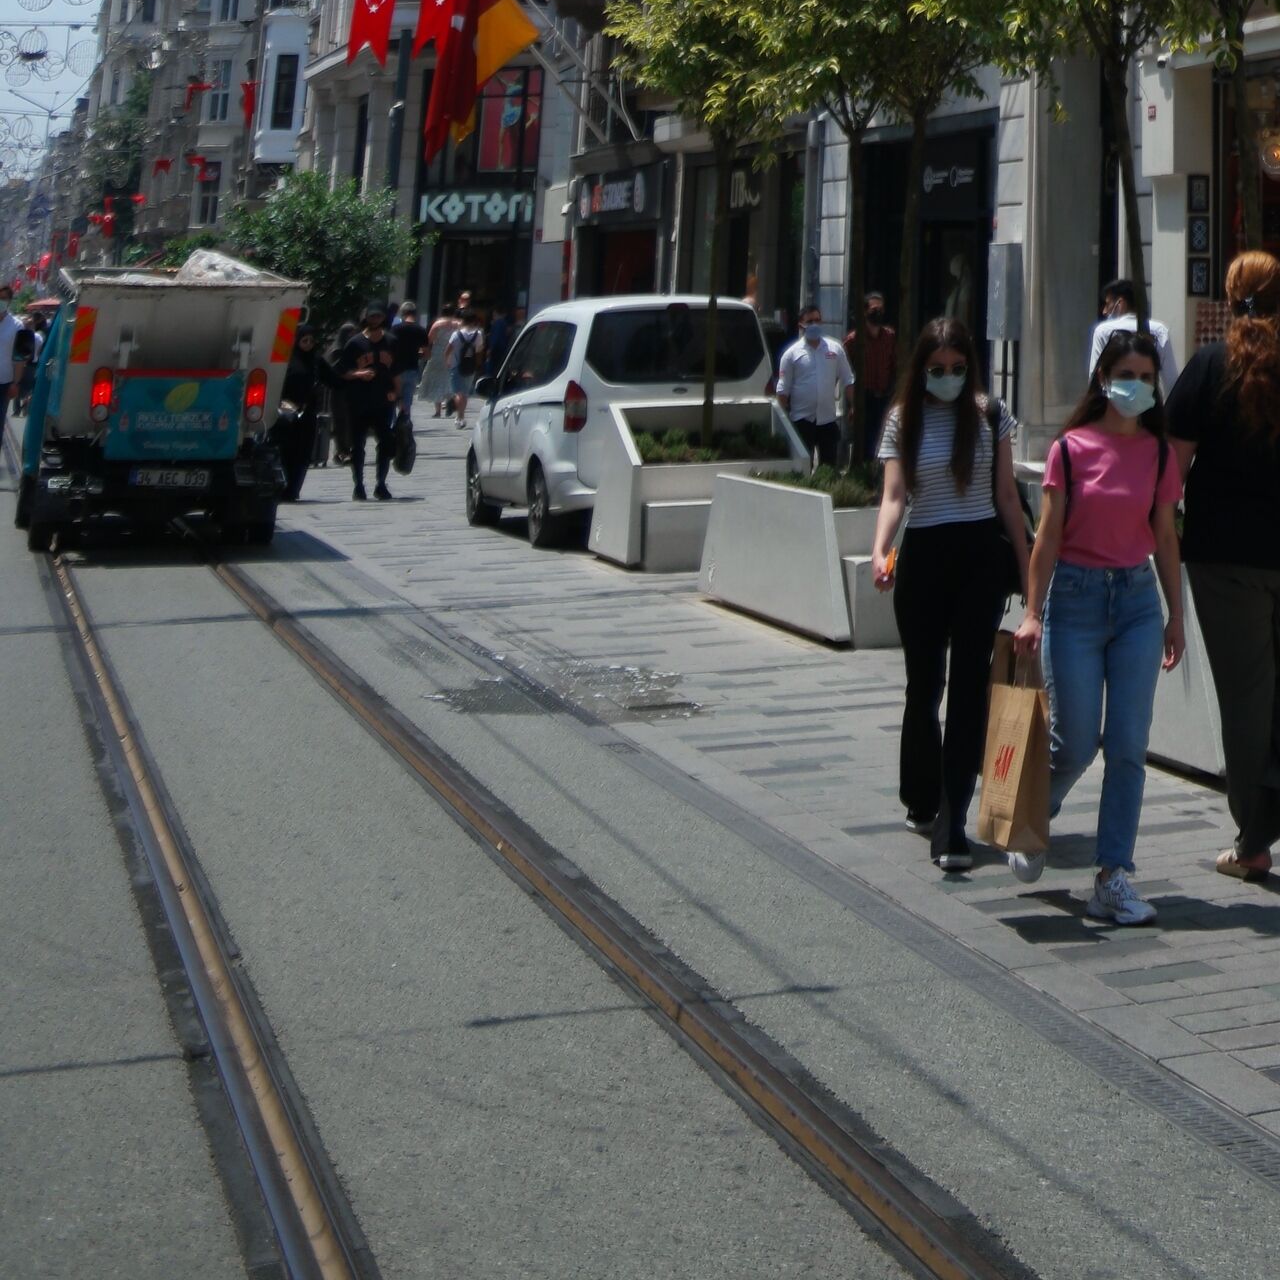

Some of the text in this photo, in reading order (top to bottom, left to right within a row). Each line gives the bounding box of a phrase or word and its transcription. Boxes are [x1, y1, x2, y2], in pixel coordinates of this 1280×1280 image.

[137, 471, 206, 485] 34 AEC 039
